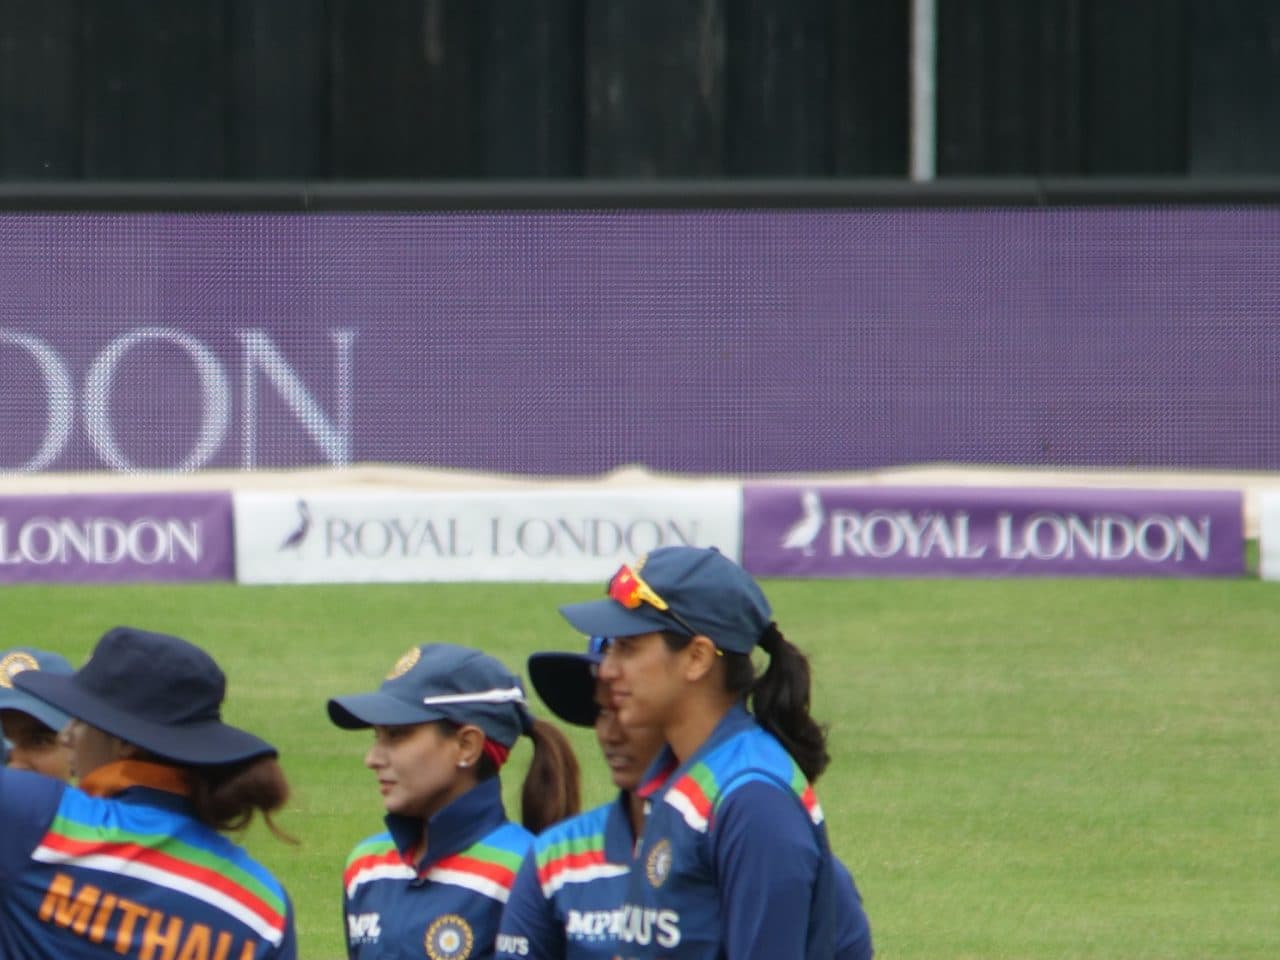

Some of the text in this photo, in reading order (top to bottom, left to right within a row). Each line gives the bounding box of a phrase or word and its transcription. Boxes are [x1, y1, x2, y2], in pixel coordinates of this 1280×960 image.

[324, 517, 700, 559] ROYAL LONDON
[831, 512, 1211, 562] ROYAL LONDON
